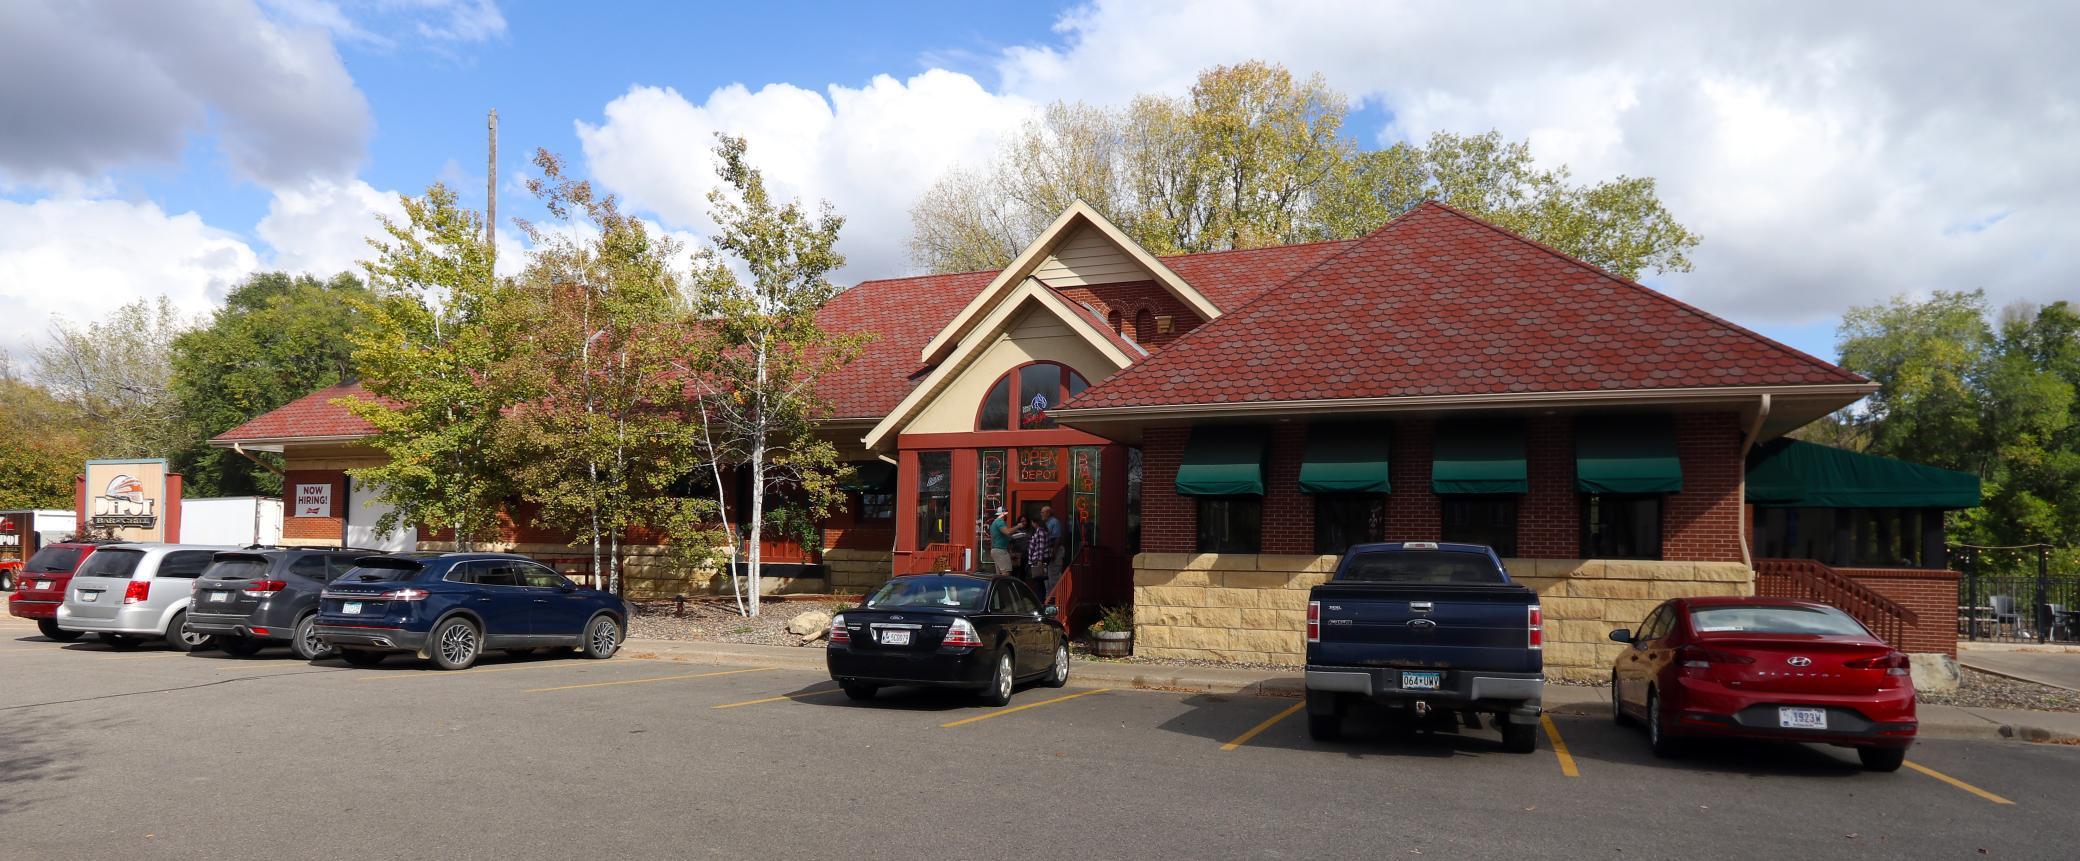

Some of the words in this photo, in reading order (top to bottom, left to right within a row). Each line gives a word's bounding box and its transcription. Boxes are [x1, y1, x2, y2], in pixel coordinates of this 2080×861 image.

[1021, 469, 1057, 480] DEPOT
[303, 486, 323, 495] NOW
[298, 496, 328, 505] HIRING!
[95, 496, 154, 516] DEPOT
